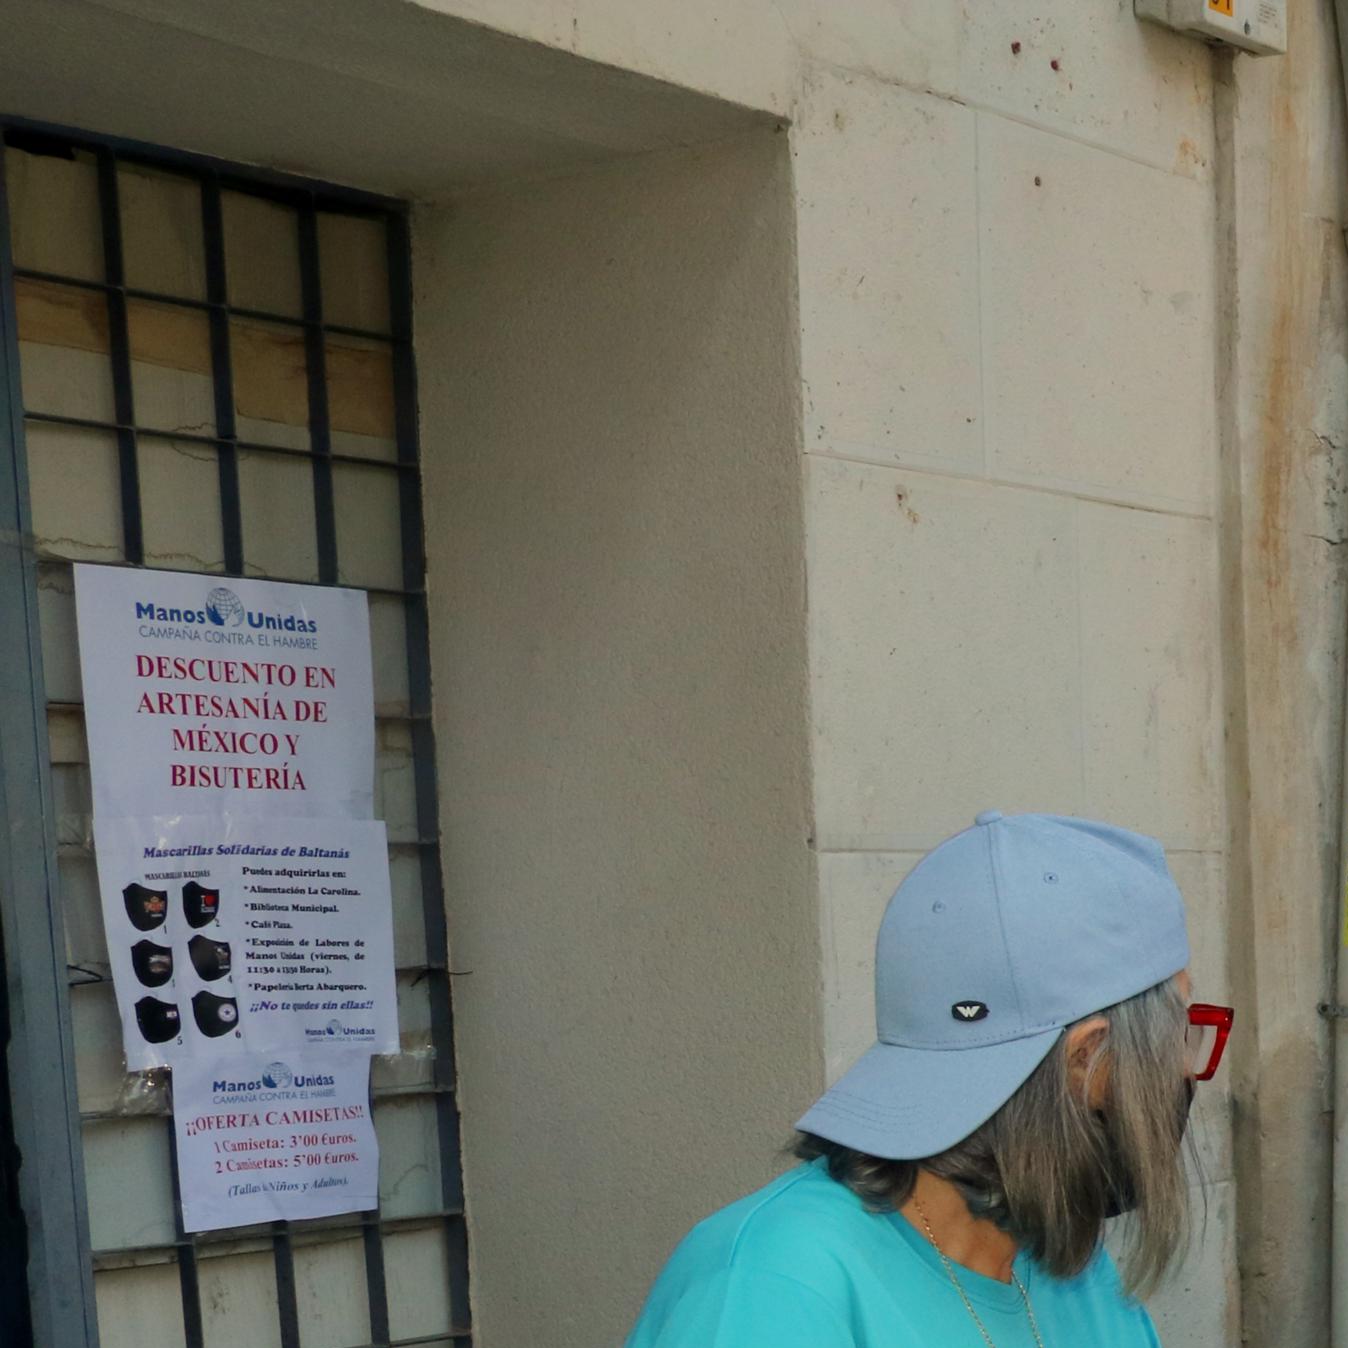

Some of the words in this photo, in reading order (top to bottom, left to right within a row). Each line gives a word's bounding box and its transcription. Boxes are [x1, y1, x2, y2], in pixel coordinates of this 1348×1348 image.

[136, 602, 205, 625] Manos
[247, 611, 317, 633] Unidas
[139, 625, 201, 641] CAMPAÑA
[204, 630, 254, 646] CONTRA
[258, 633, 271, 647] EL
[273, 634, 318, 650] HAMBRE
[136, 654, 296, 685] DESCUENTO
[304, 667, 337, 689] EN
[137, 692, 287, 721] ARTESANÍA
[295, 700, 327, 723] DE
[172, 725, 279, 755] MÉXICO
[284, 734, 300, 756] Y
[170, 760, 307, 791] BISUTERÍA
[143, 845, 213, 859] Mascarillas
[215, 844, 278, 858] Solidarias
[281, 846, 296, 857] de
[299, 846, 350, 859] Baltanás
[275, 869, 330, 878] adquirirlas
[308, 887, 318, 895] La
[321, 888, 361, 896] Carolina.
[292, 904, 339, 913] Municipal.
[299, 939, 309, 947] de
[315, 939, 349, 947] Labores
[245, 952, 277, 960] Manos
[354, 952, 365, 960] de
[281, 1001, 291, 1010] te
[321, 1001, 338, 1010] sin
[212, 1080, 261, 1092] Manos
[293, 1074, 335, 1087] Unidas
[259, 1091, 297, 1102] CONTRA
[185, 1113, 260, 1137] ¡¡OFERTA
[265, 1105, 365, 1126] CAMISETAS!!
[223, 1137, 285, 1153] Camiseta:
[215, 1160, 223, 1174] 2
